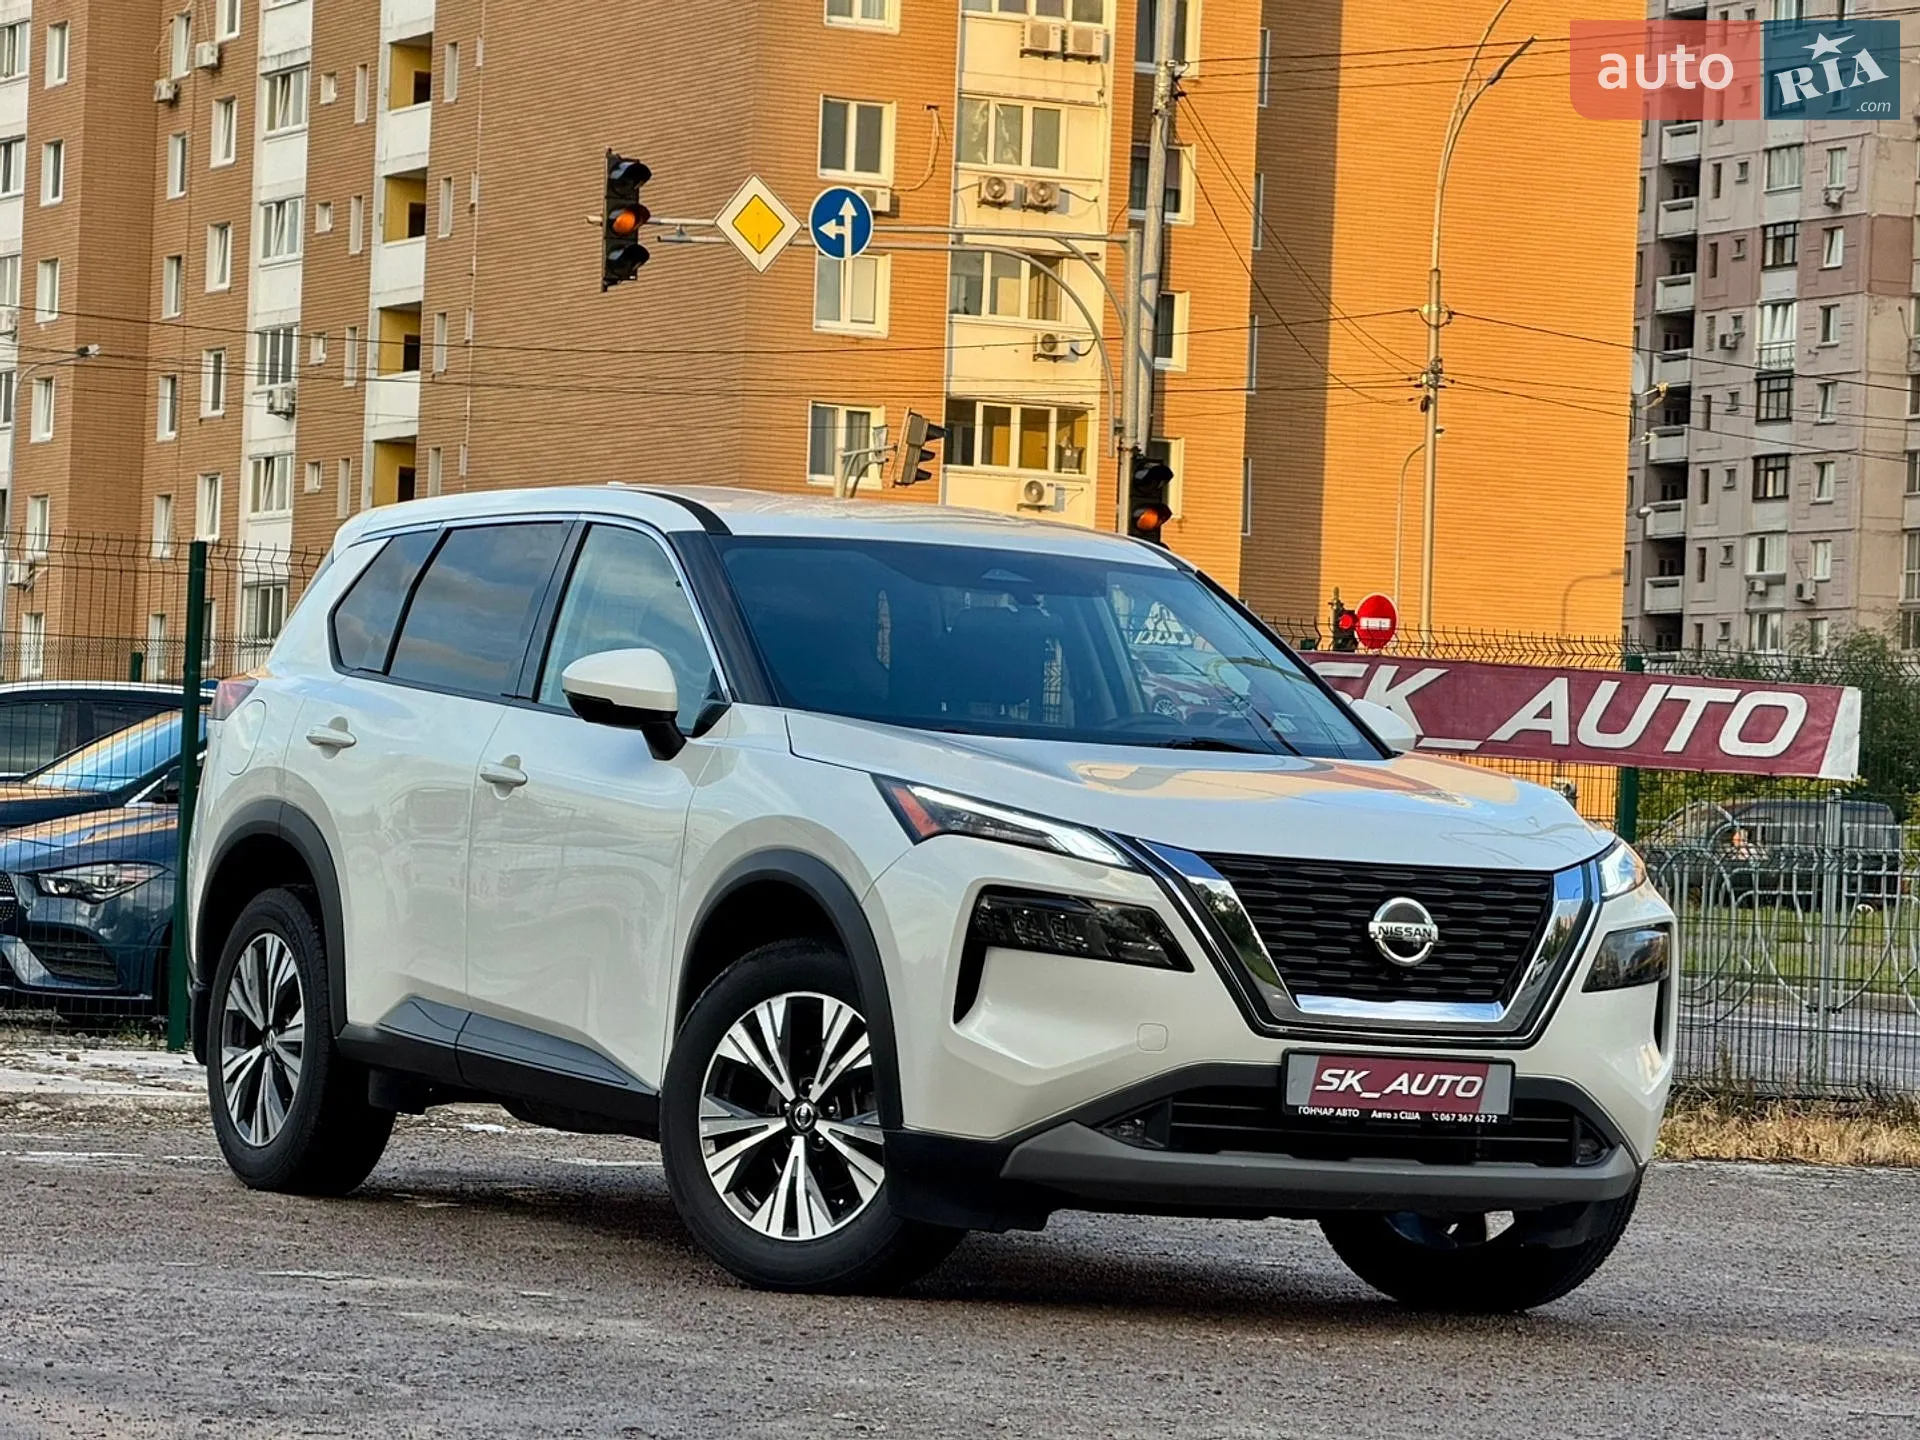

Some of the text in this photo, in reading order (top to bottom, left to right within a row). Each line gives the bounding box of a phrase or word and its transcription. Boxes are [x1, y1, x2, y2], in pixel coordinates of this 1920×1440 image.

[1378, 925, 1432, 938] NISSAN
[1315, 1069, 1484, 1099] SK_AUTO
[1298, 1106, 1335, 1116] ГОНЧАР
[1335, 1108, 1360, 1118] АВТО
[1399, 1111, 1421, 1120] США
[1439, 1113, 1456, 1122] 067
[1457, 1113, 1473, 1123] 367
[1475, 1114, 1486, 1123] 62
[1487, 1114, 1498, 1123] 72
